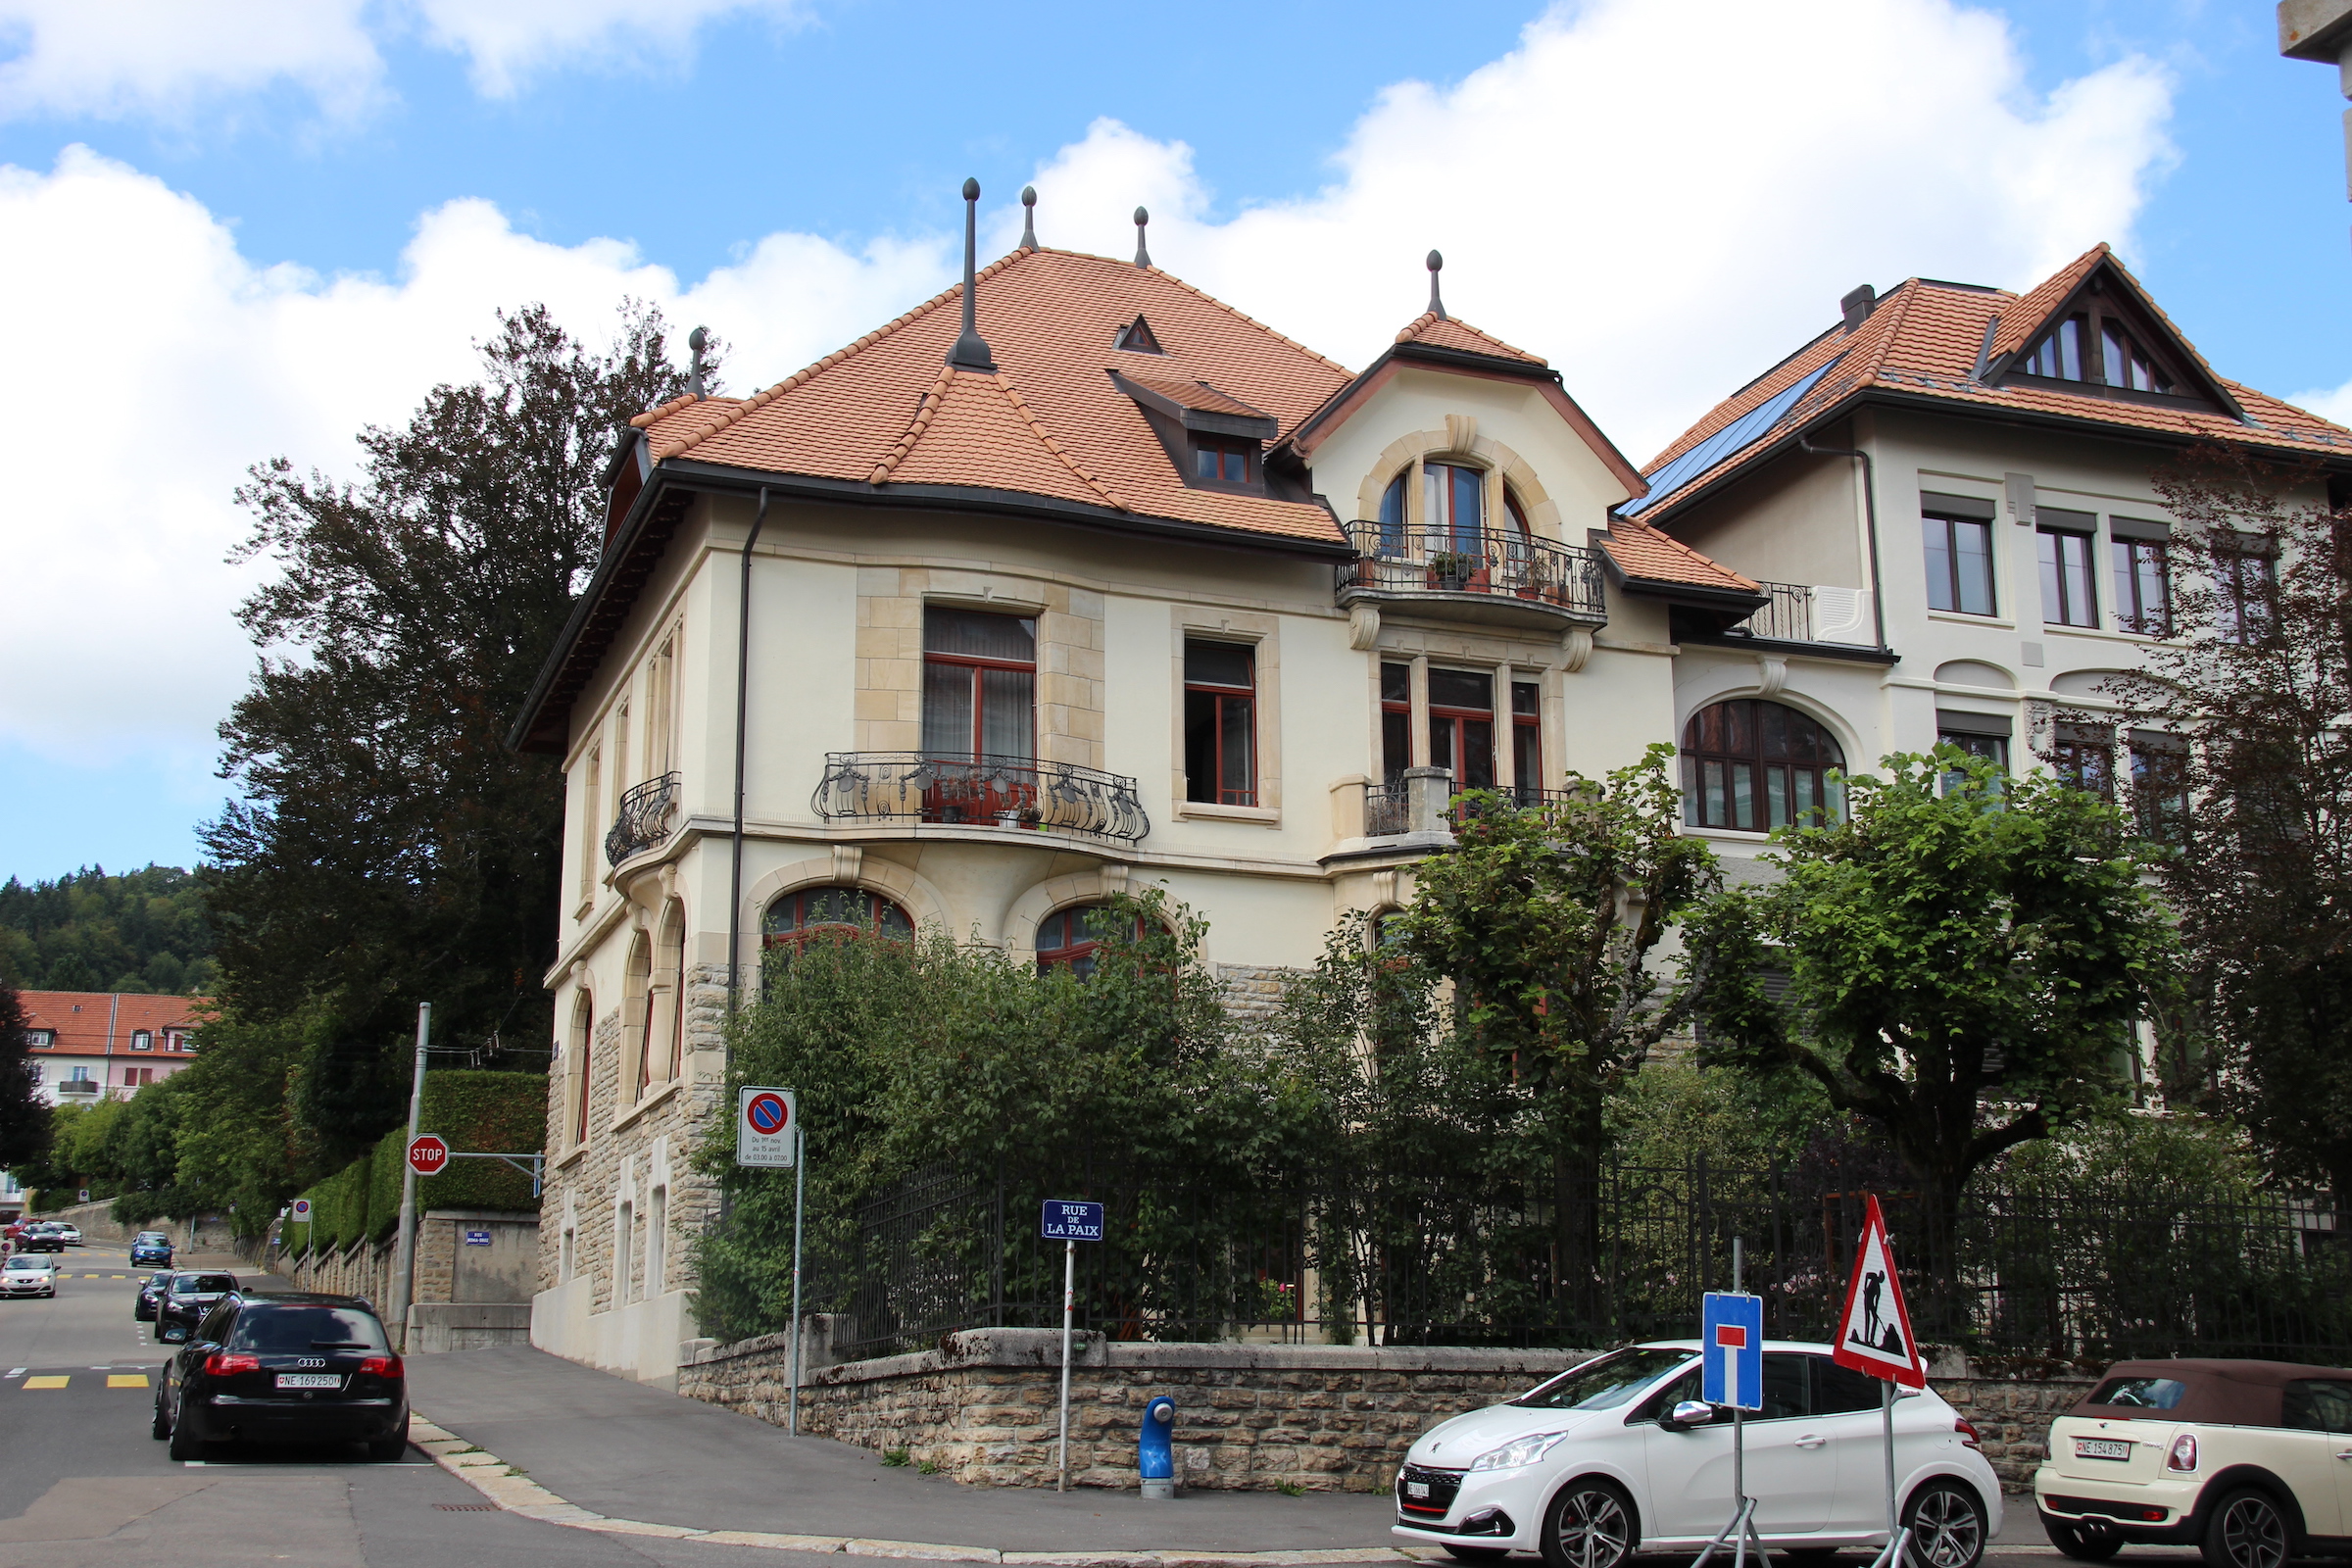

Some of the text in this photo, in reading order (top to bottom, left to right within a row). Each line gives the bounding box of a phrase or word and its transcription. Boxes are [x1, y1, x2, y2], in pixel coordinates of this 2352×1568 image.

[413, 1148, 443, 1161] STOP
[1061, 1204, 1088, 1216] RUE
[1047, 1223, 1099, 1237] LA PAIX
